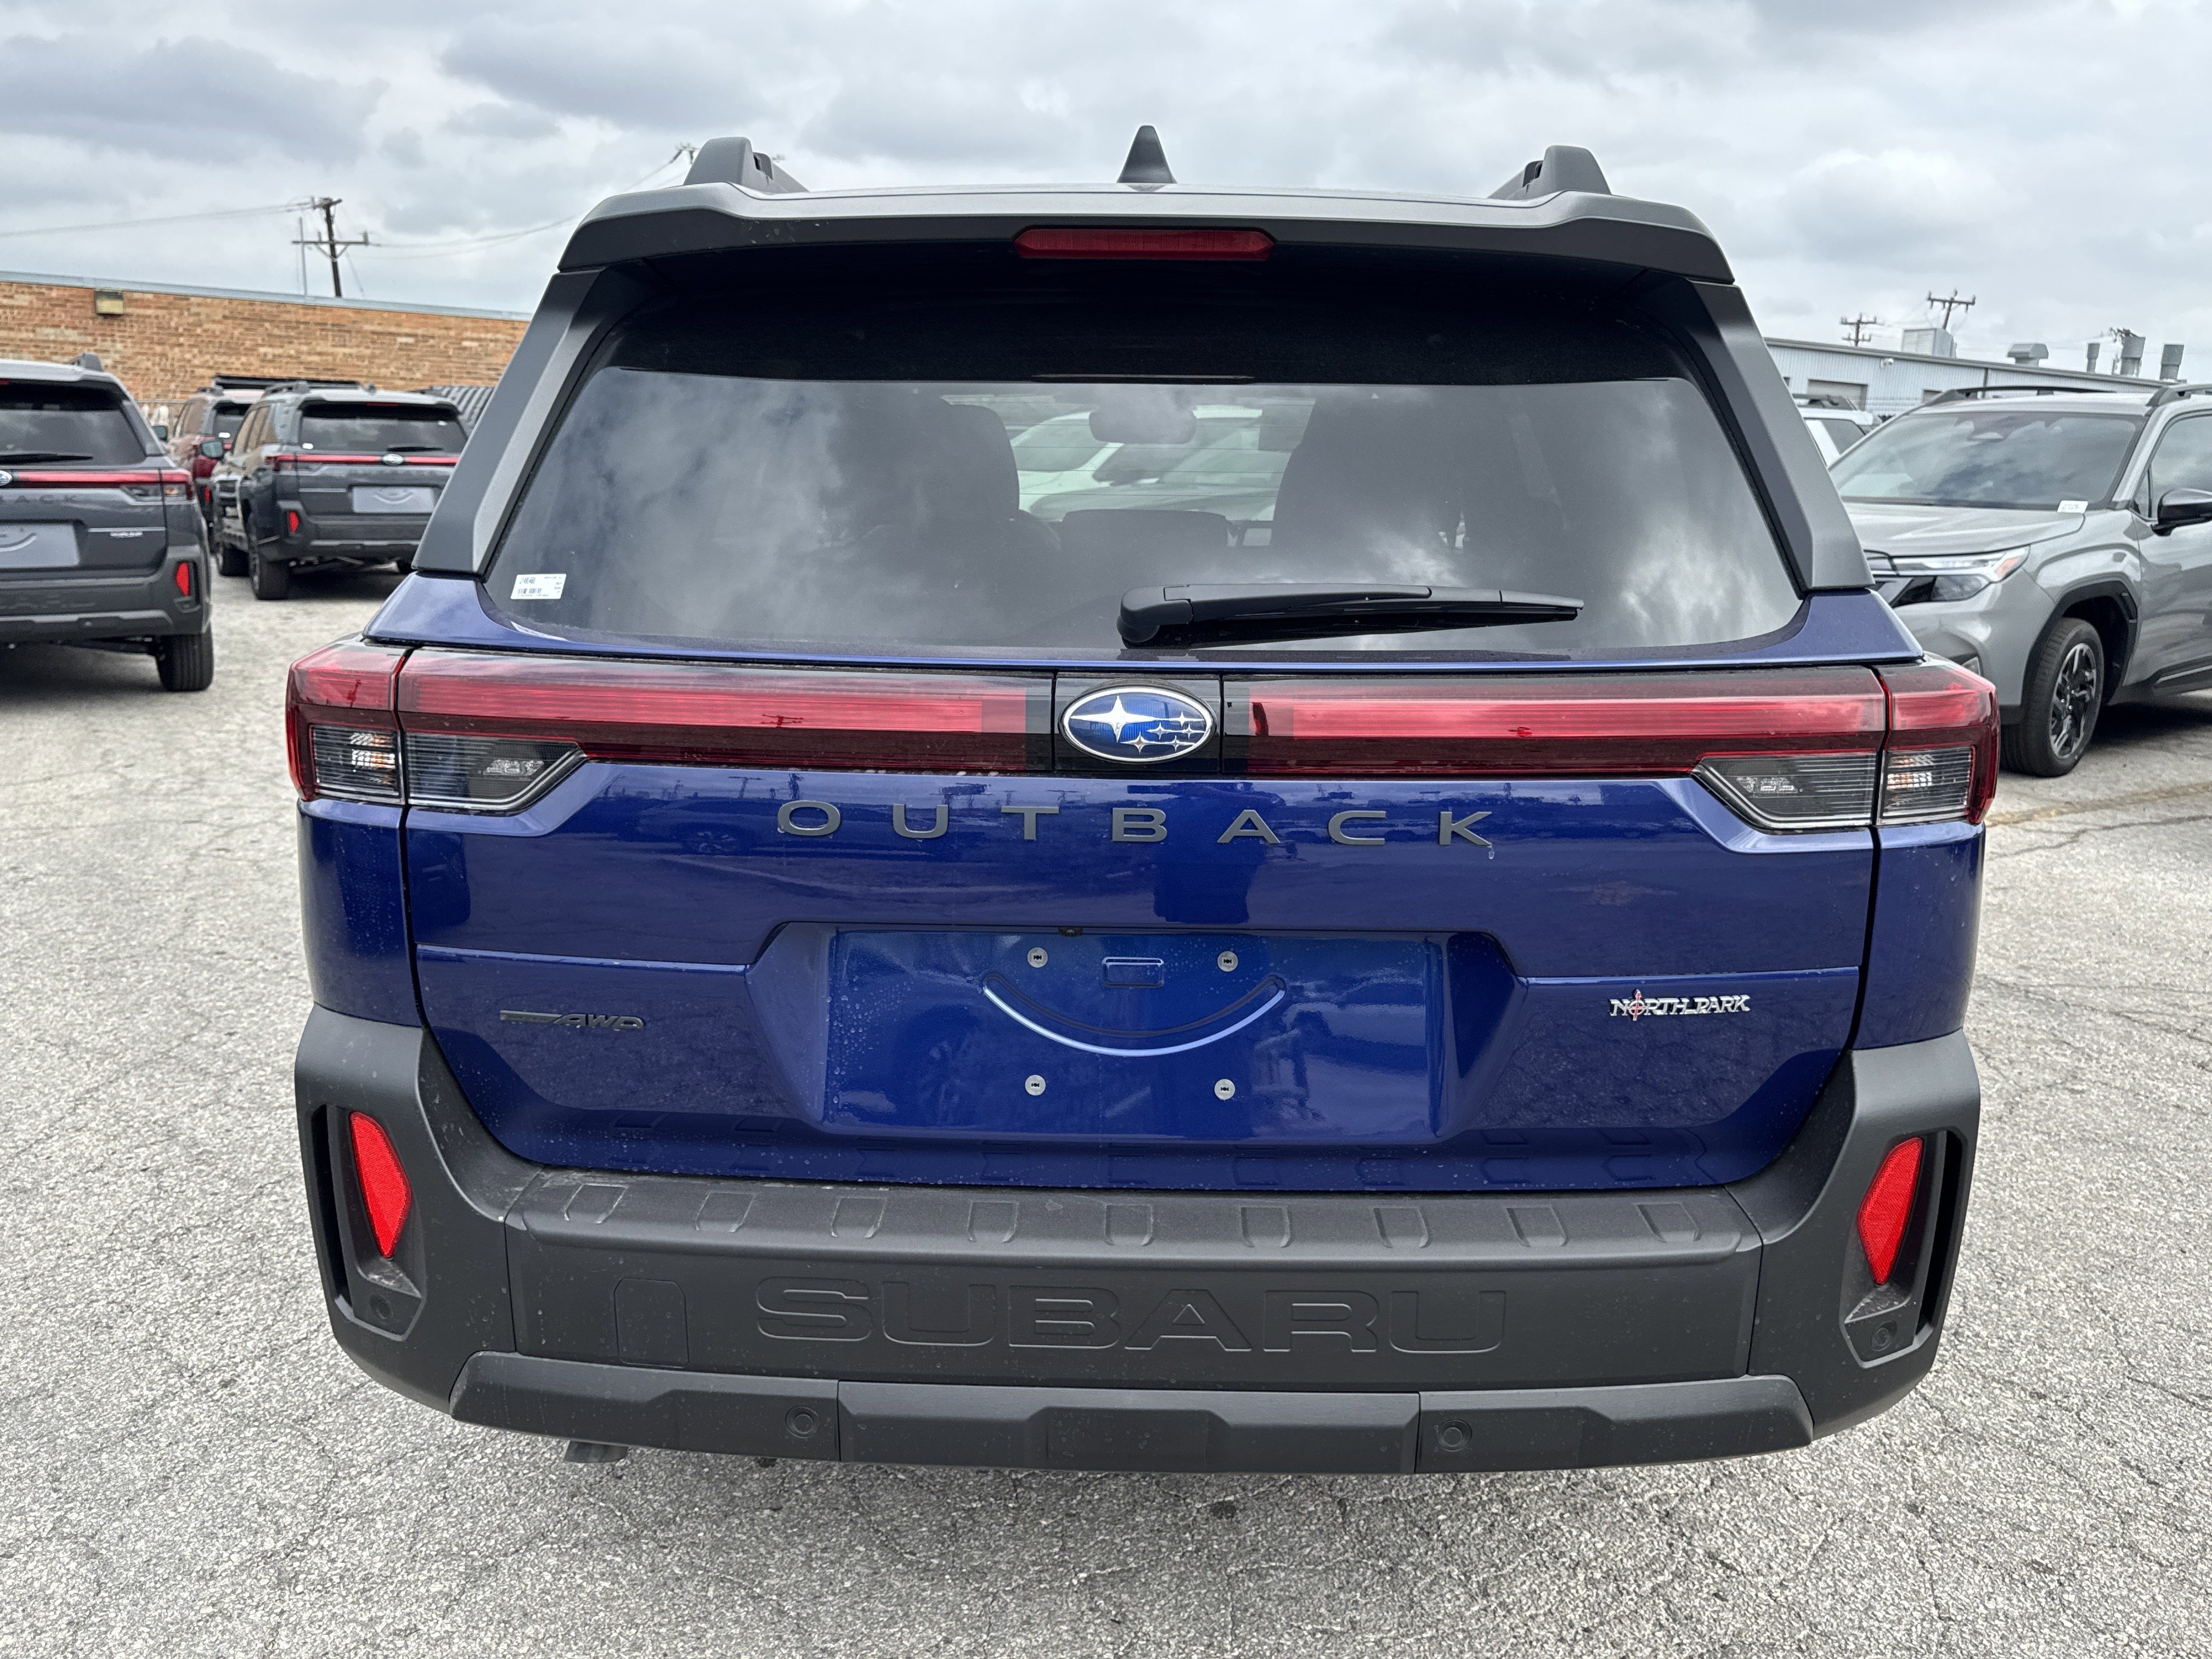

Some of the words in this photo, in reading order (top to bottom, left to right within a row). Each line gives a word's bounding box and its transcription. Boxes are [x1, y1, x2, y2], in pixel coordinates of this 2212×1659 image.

[777, 799, 1492, 845] OUTBACK
[554, 1013, 645, 1030] AWD
[755, 1276, 1506, 1354] SUBARU
